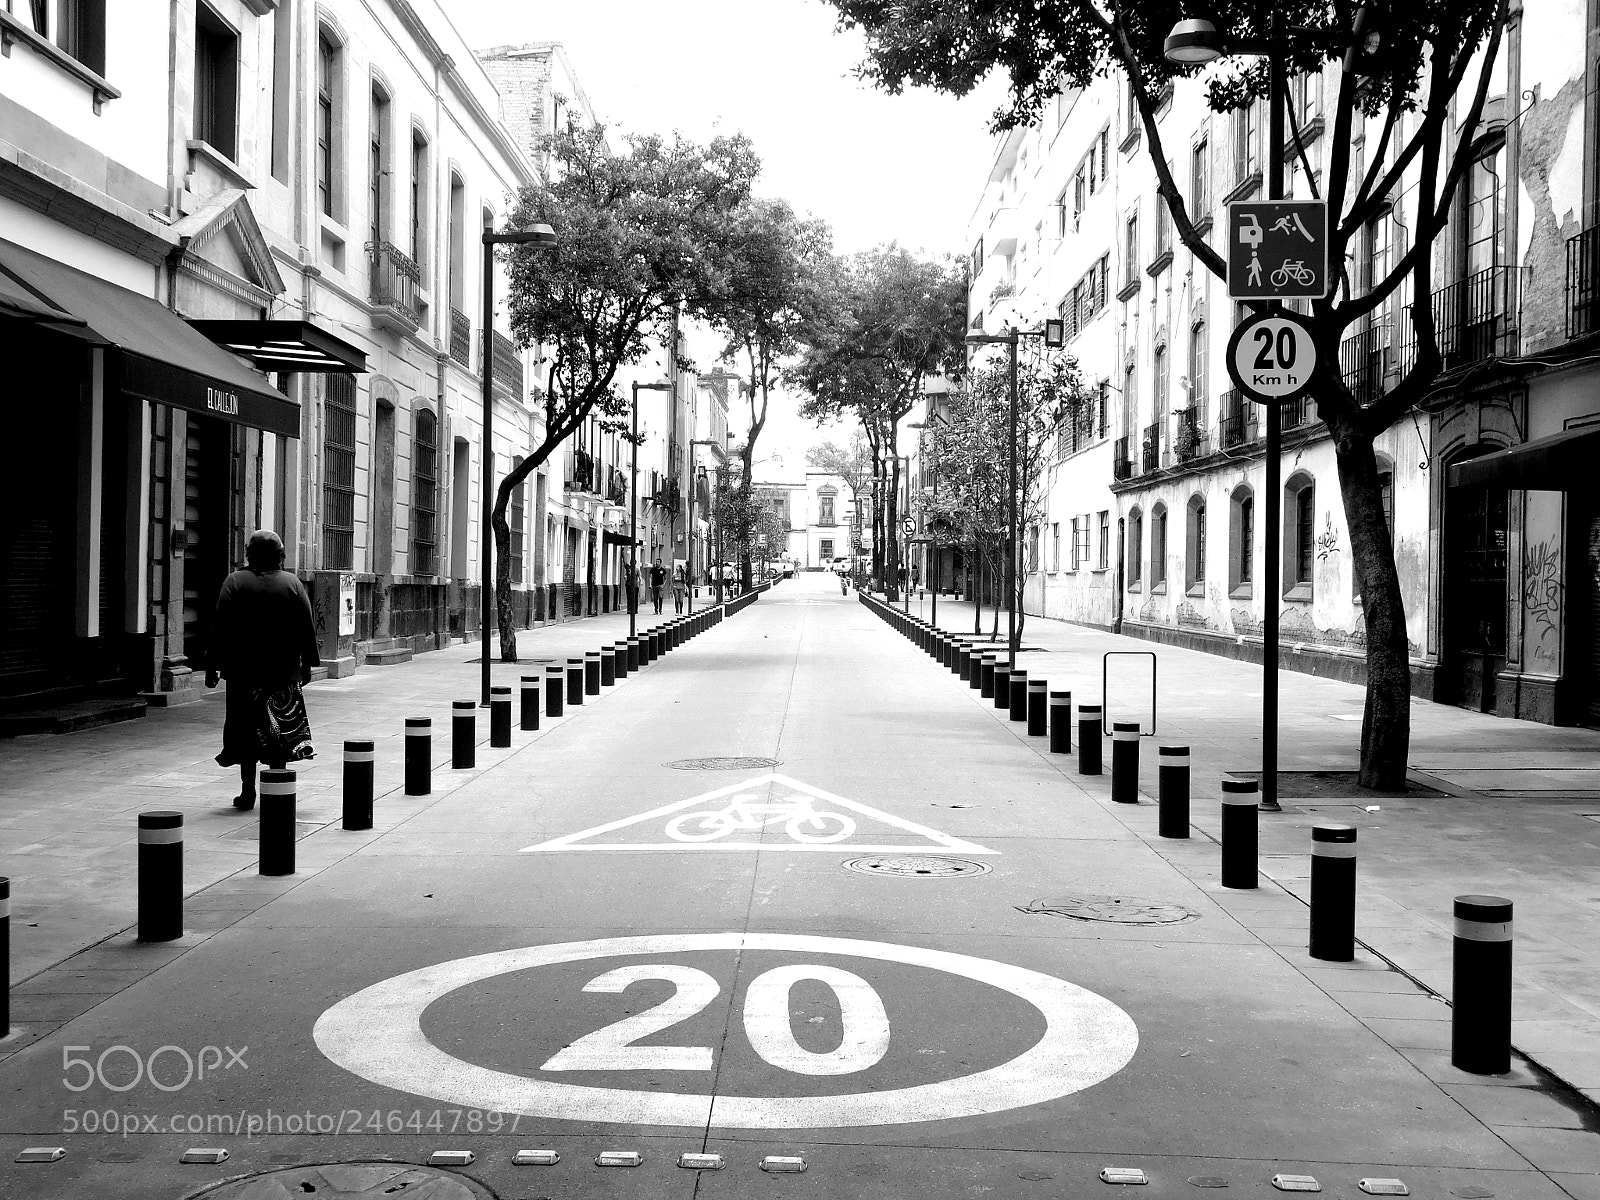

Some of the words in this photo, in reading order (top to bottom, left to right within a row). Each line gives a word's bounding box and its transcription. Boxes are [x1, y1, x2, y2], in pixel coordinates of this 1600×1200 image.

[1253, 326, 1297, 370] 20
[1253, 374, 1281, 385] Km
[1287, 373, 1297, 385] h
[208, 387, 214, 409] EL
[539, 964, 891, 1076] 20
